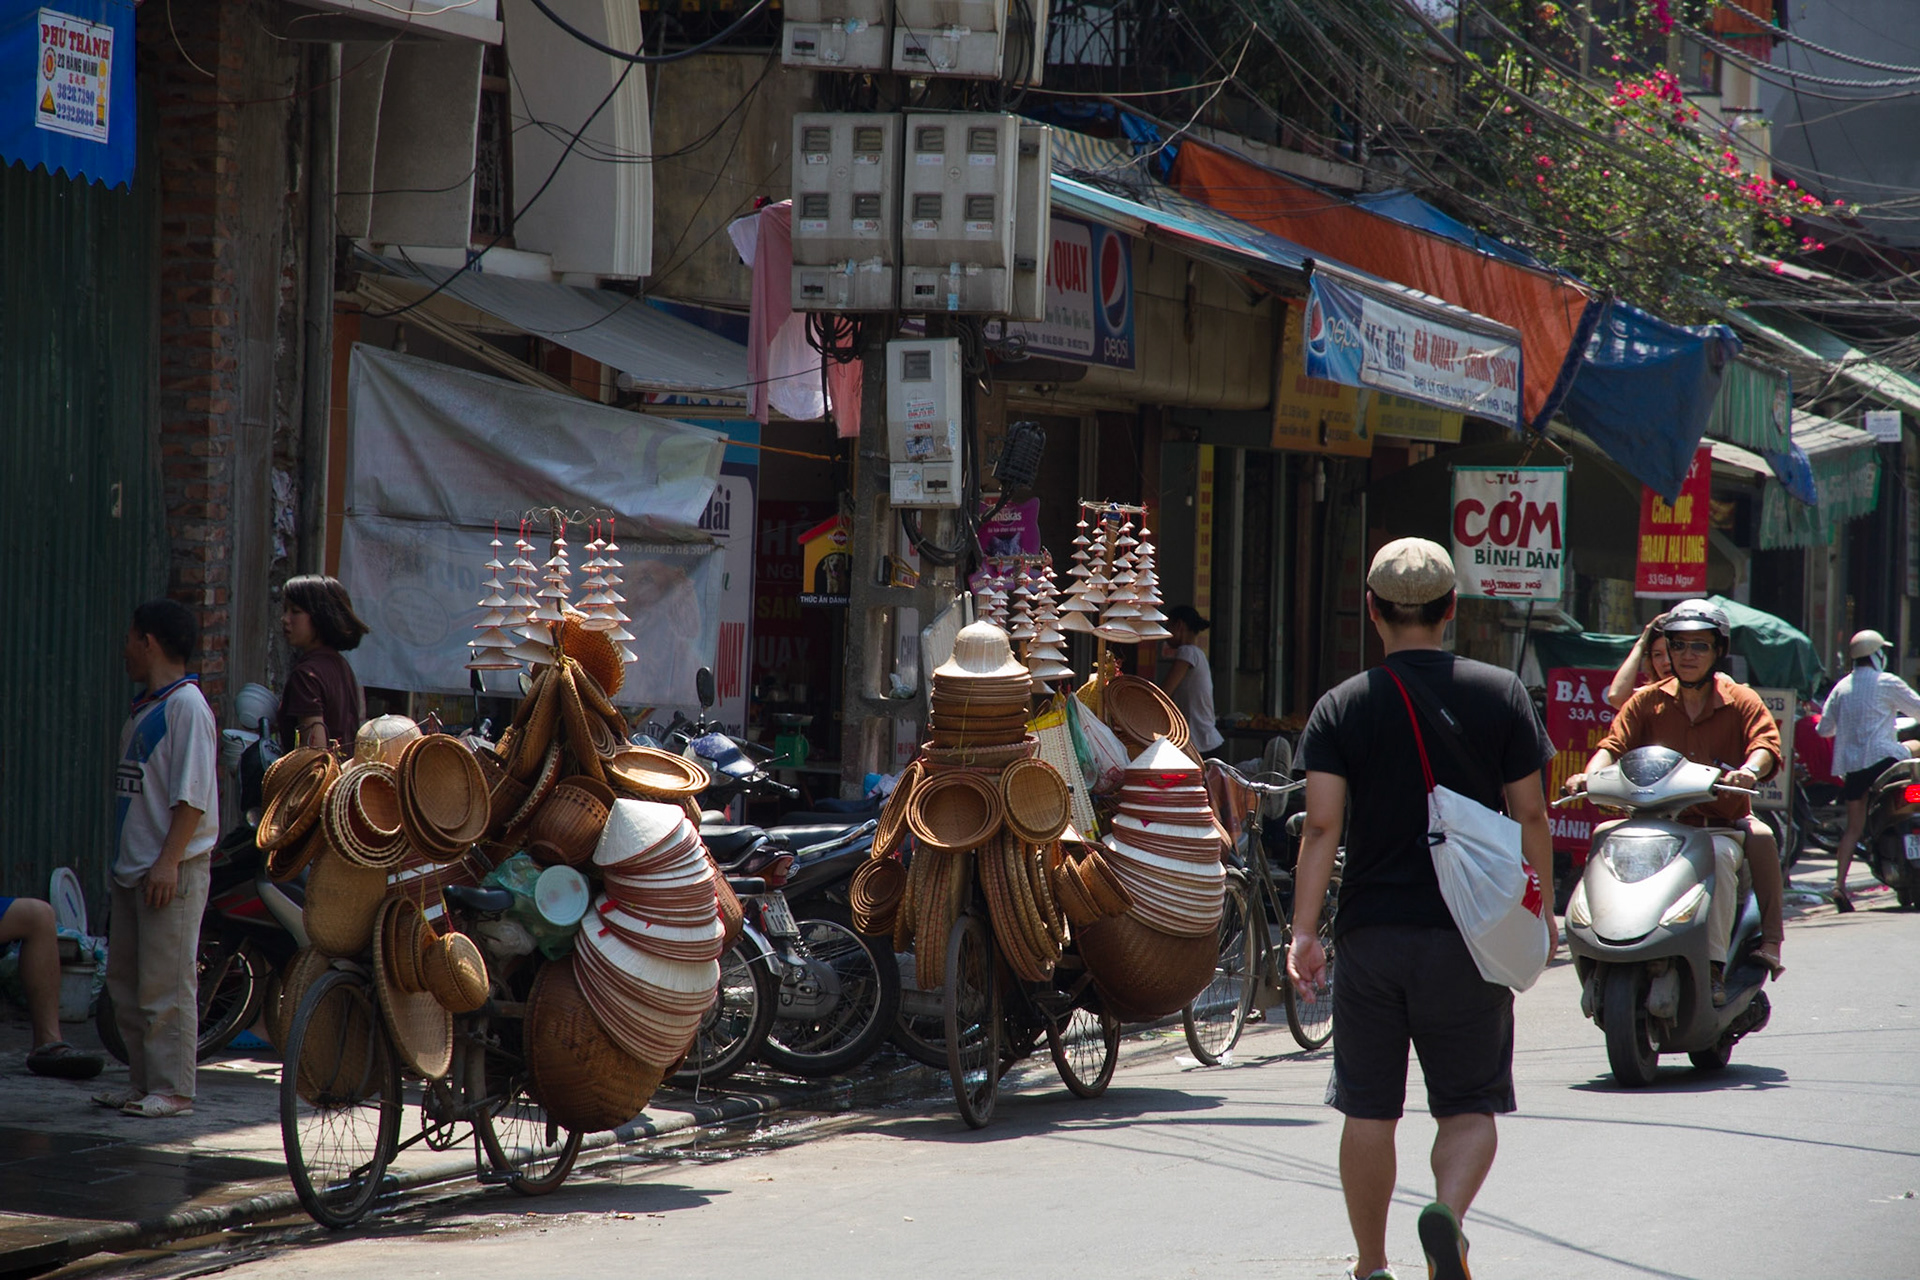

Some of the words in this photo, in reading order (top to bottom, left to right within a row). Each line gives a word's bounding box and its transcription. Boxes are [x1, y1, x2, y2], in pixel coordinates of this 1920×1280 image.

[41, 21, 67, 48] PHÚ
[69, 27, 111, 60] THÀNH
[1054, 239, 1088, 295] QUAY
[1104, 336, 1129, 364] pepsi
[1413, 325, 1428, 364] GÀ
[1430, 334, 1459, 373] QUAY
[1475, 542, 1520, 566] BÌNH
[1526, 548, 1559, 569] DÂN
[1668, 535, 1680, 571] HẠ
[1681, 535, 1706, 563] LONG
[1497, 581, 1521, 589] TRONG
[1658, 574, 1673, 585] Gia
[717, 621, 745, 707] QUAY
[1555, 676, 1594, 704] BÀ
[1568, 708, 1596, 722] 33A
[1549, 814, 1591, 840] BÁNH
